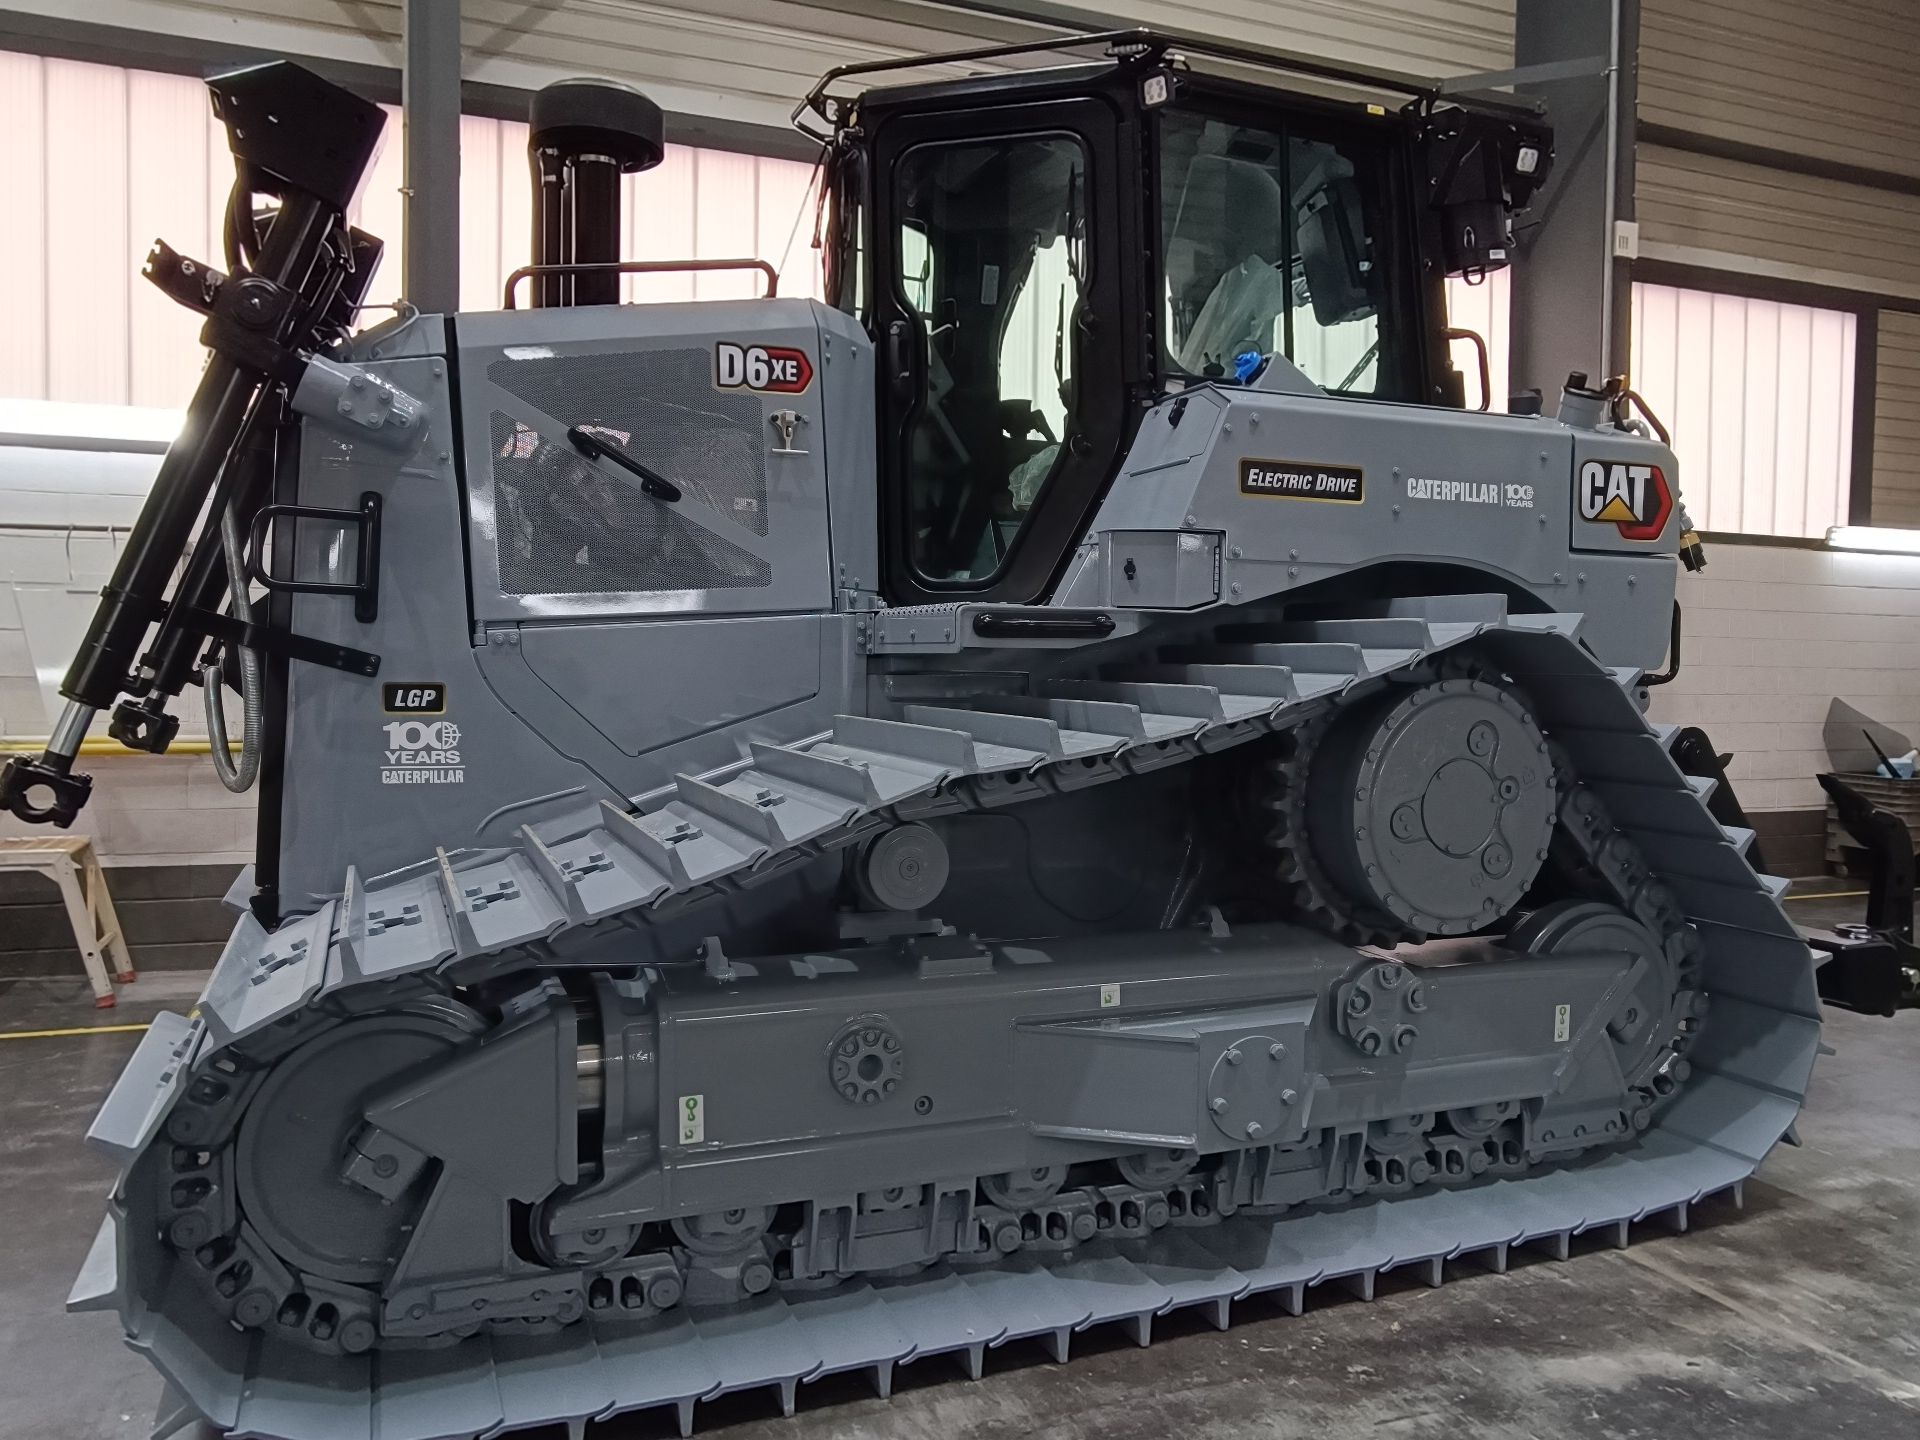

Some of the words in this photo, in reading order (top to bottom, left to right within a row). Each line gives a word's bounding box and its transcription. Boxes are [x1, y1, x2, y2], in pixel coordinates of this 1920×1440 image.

[1247, 468, 1313, 490] ELECTRIC
[1315, 473, 1357, 493] DRIVE
[1407, 477, 1499, 504] CATERPILLAR
[1504, 483, 1535, 500] 100
[1581, 461, 1651, 522] CAT
[1505, 499, 1534, 508] YEARS
[394, 689, 437, 707] LGP
[382, 721, 462, 750] 100
[384, 750, 461, 764] YEARS
[381, 769, 465, 784] CATERPILLAR
